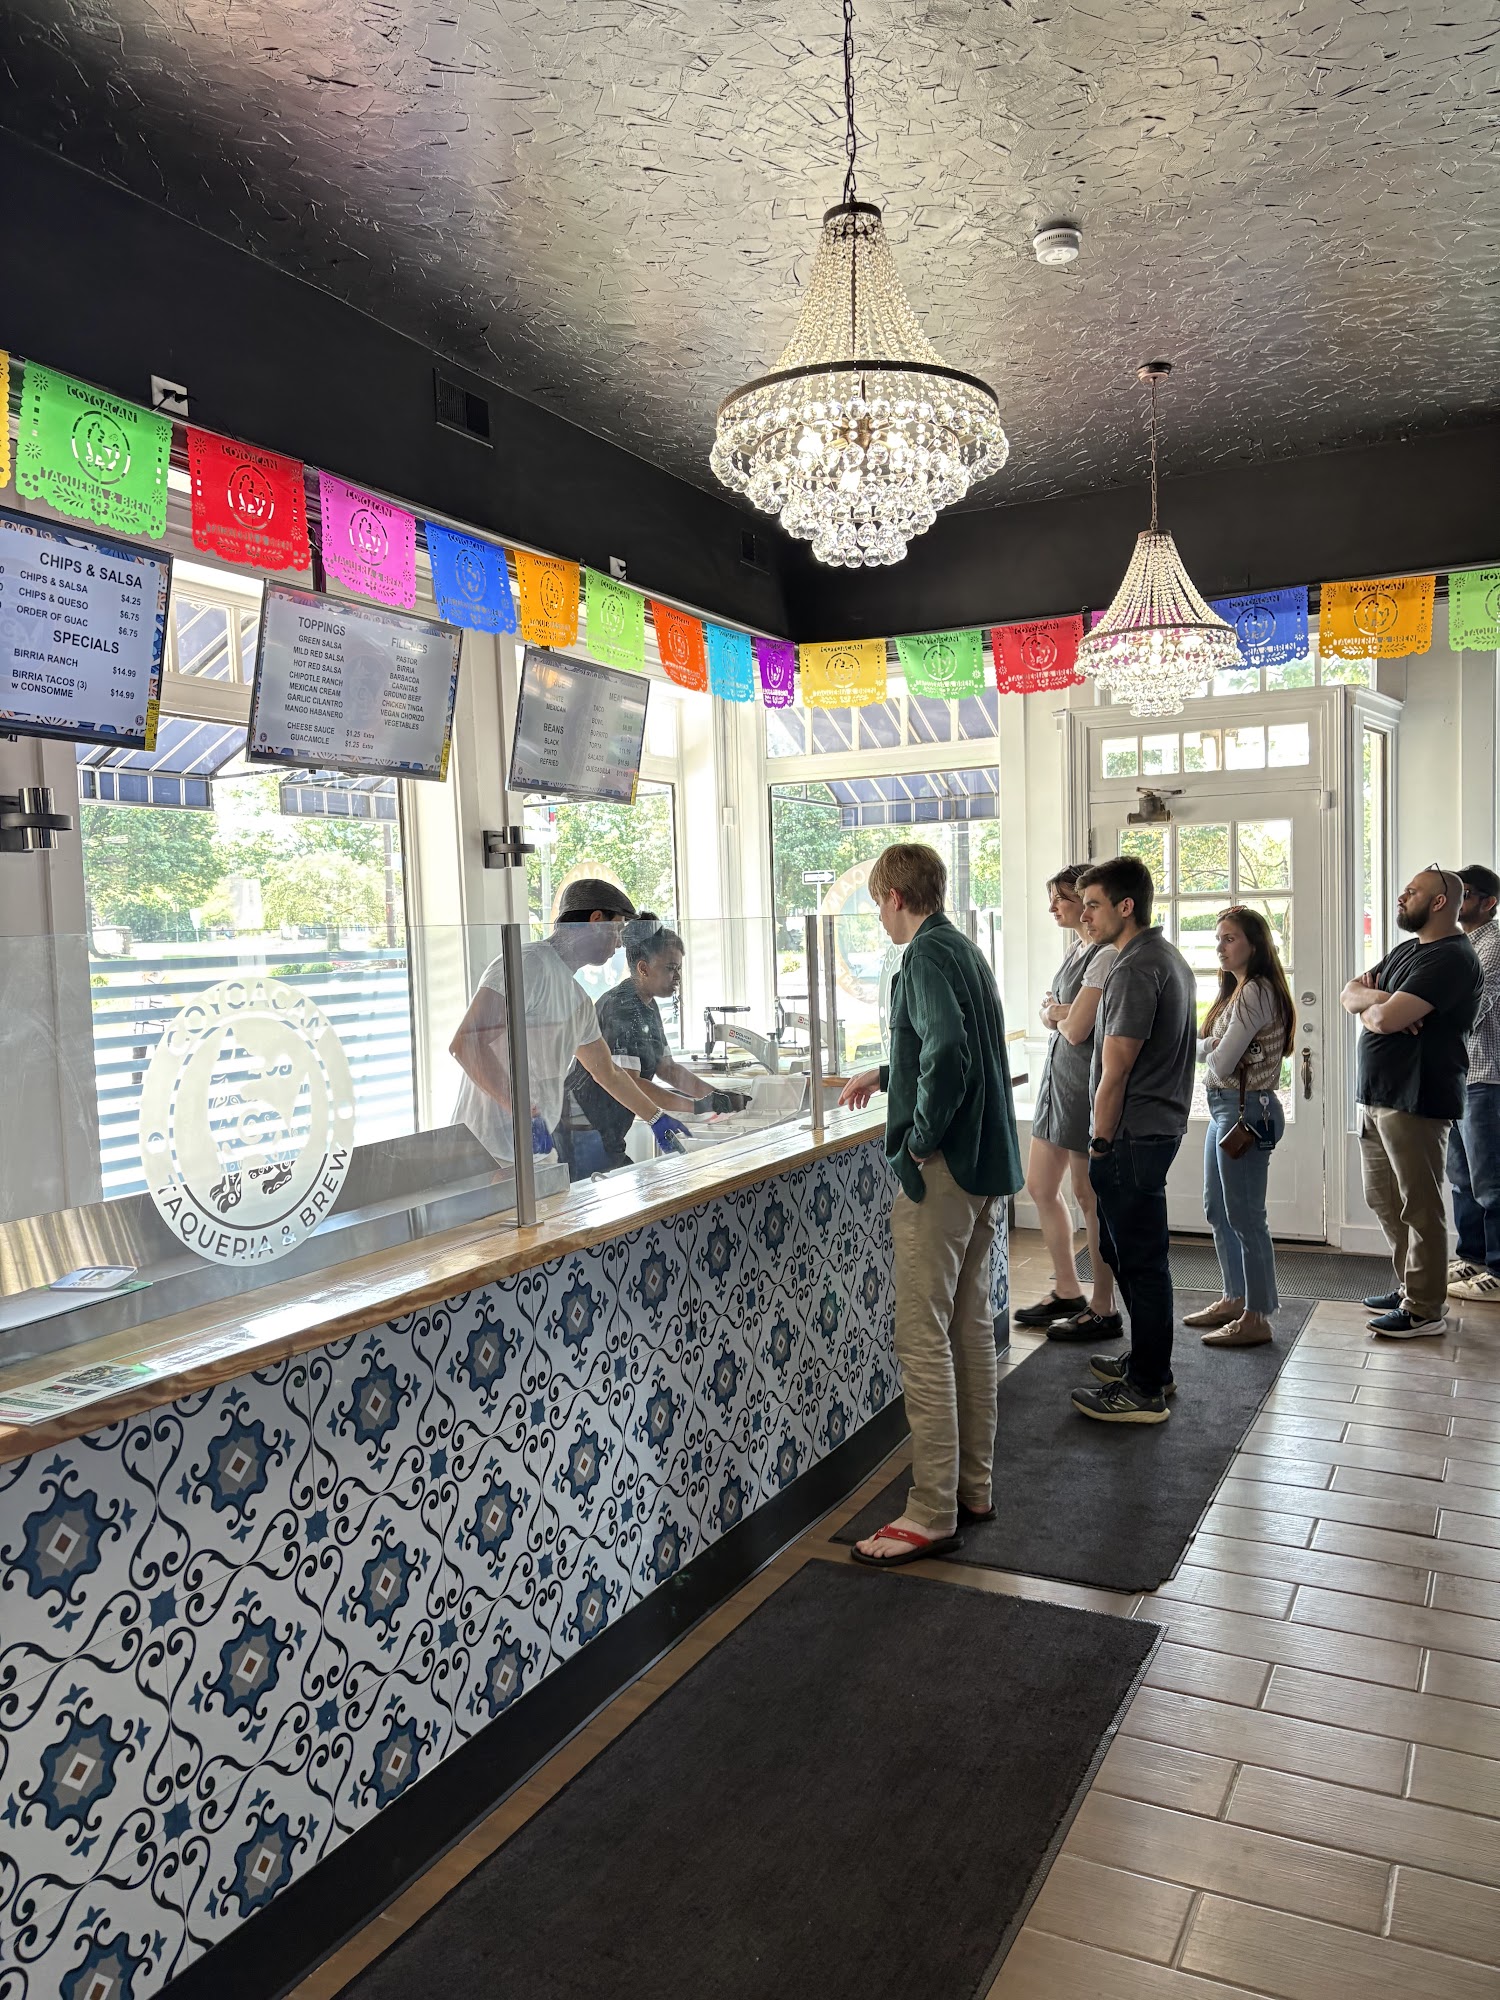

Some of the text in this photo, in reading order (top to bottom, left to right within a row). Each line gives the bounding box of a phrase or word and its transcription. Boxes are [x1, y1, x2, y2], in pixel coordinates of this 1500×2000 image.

[67, 385, 137, 423] COYOACAN
[41, 468, 104, 500] TAQUERIA
[109, 490, 117, 501] &
[40, 552, 143, 589] CHIPS & SALSA
[20, 570, 141, 606] CHIPS & SALSA $4.25
[19, 587, 140, 621] CHIPS & QUESO $6.75
[16, 605, 138, 638] ORDER OF GUAC $6.75
[298, 616, 346, 636] TOPPINGS
[53, 630, 119, 654] SPECIALS
[298, 634, 342, 650] GREEN SALSA
[293, 646, 345, 663] MILD RED SALSA
[396, 655, 418, 666] PASTOR
[14, 648, 136, 678] BIRRIA RANCH $14.99
[293, 659, 342, 674] HOT RED SALSA
[396, 664, 415, 674] BIRRIA
[12, 669, 87, 691] BIRRIA TACOS (3)
[289, 670, 343, 687] CHIPOTLE RANCH
[389, 672, 420, 684] BARBACOA
[20, 682, 74, 698] CONSOMME
[110, 688, 135, 700] $14.99
[289, 682, 341, 697] MEXICAN CREAM
[383, 690, 407, 700] GROUND
[391, 682, 418, 693] CARNITAS
[287, 693, 343, 708] GARLIC CILANTRO
[381, 699, 423, 713] CHICKEN TINGA
[284, 704, 343, 719] MANGO HABANERO
[380, 708, 425, 722] VEGAN CHORIZO
[287, 722, 313, 731] CHEESE
[313, 725, 335, 735] SAUCE
[346, 729, 361, 738] $1.25
[384, 719, 420, 730] VEGETABLES
[543, 722, 564, 735] BEANS
[290, 733, 330, 745] GUACAMOLE
[345, 740, 360, 749] $1.25
[544, 737, 560, 746] BLACK
[543, 748, 558, 757] PINTO
[157, 1141, 348, 1260] TAQUERIA & BREW
